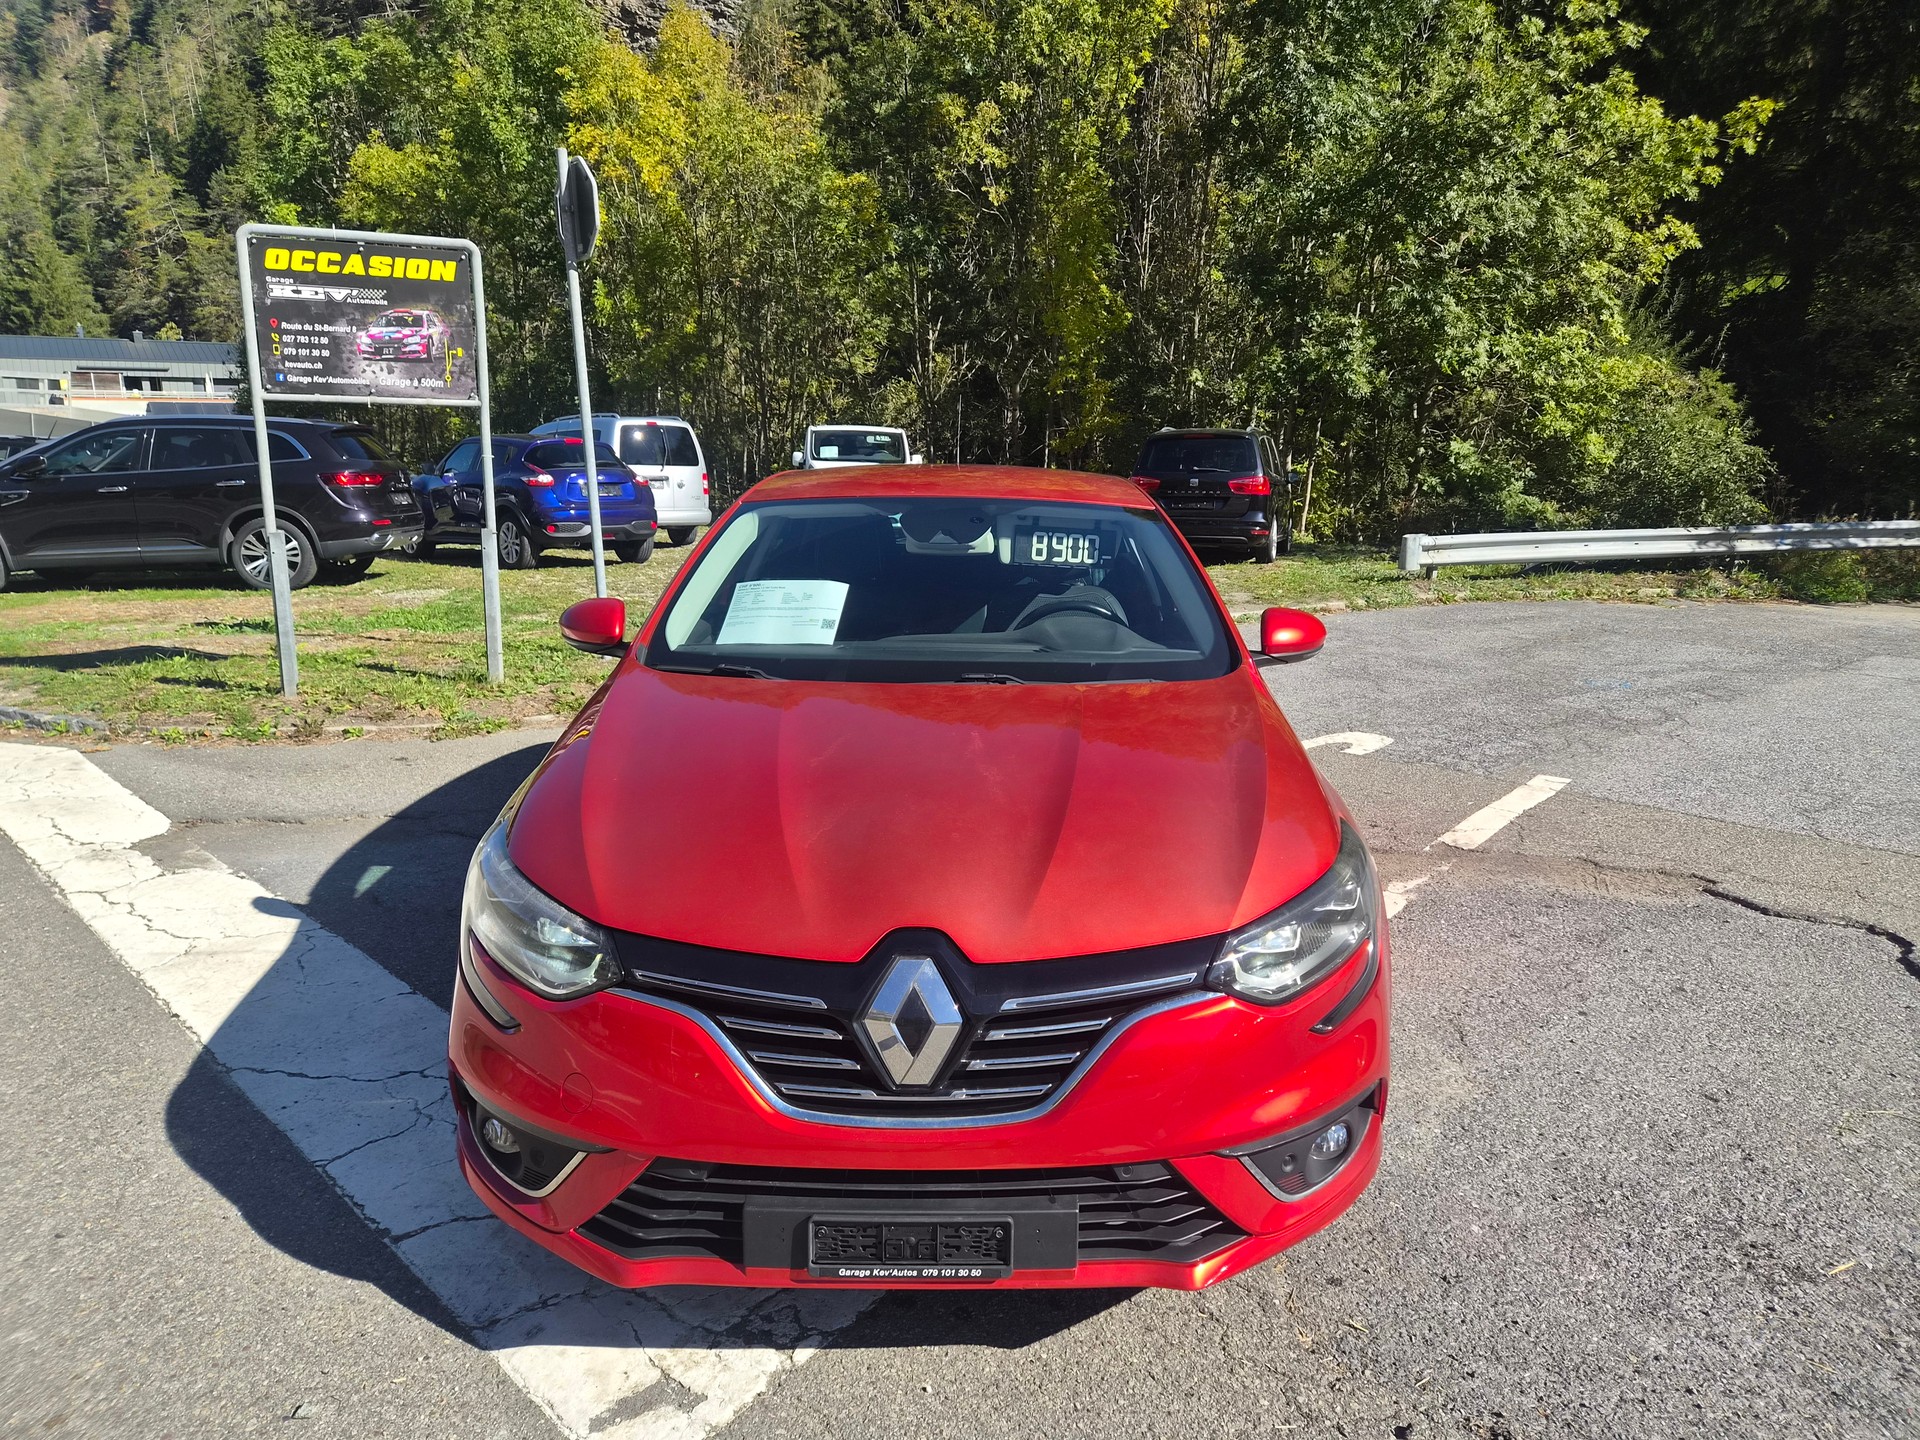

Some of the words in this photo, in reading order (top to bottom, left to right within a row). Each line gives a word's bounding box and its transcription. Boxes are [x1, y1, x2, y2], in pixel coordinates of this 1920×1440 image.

[264, 248, 457, 281] OCCASION
[265, 275, 294, 284] Garage
[346, 297, 388, 306] Automobile
[281, 321, 302, 330] Route
[303, 323, 312, 331] du
[314, 323, 351, 333] St-Bernard
[352, 325, 357, 333] 8
[296, 335, 309, 344] 783
[310, 336, 319, 344] 12
[320, 336, 329, 344] 50
[284, 347, 296, 355] 079
[298, 348, 310, 356] 101
[321, 349, 330, 357] 50
[285, 360, 323, 369] kevauto.ch
[286, 374, 312, 384] Garage
[313, 375, 370, 385] Kev'Automobiles
[379, 377, 411, 388] Garage
[413, 377, 420, 387] à
[420, 378, 444, 388] 500m
[838, 1268, 871, 1278] Garage
[872, 1268, 918, 1277] Kev'Autos
[922, 1268, 938, 1277] 079
[940, 1268, 956, 1277] 101
[957, 1268, 969, 1277] 30
[970, 1268, 982, 1277] 50
